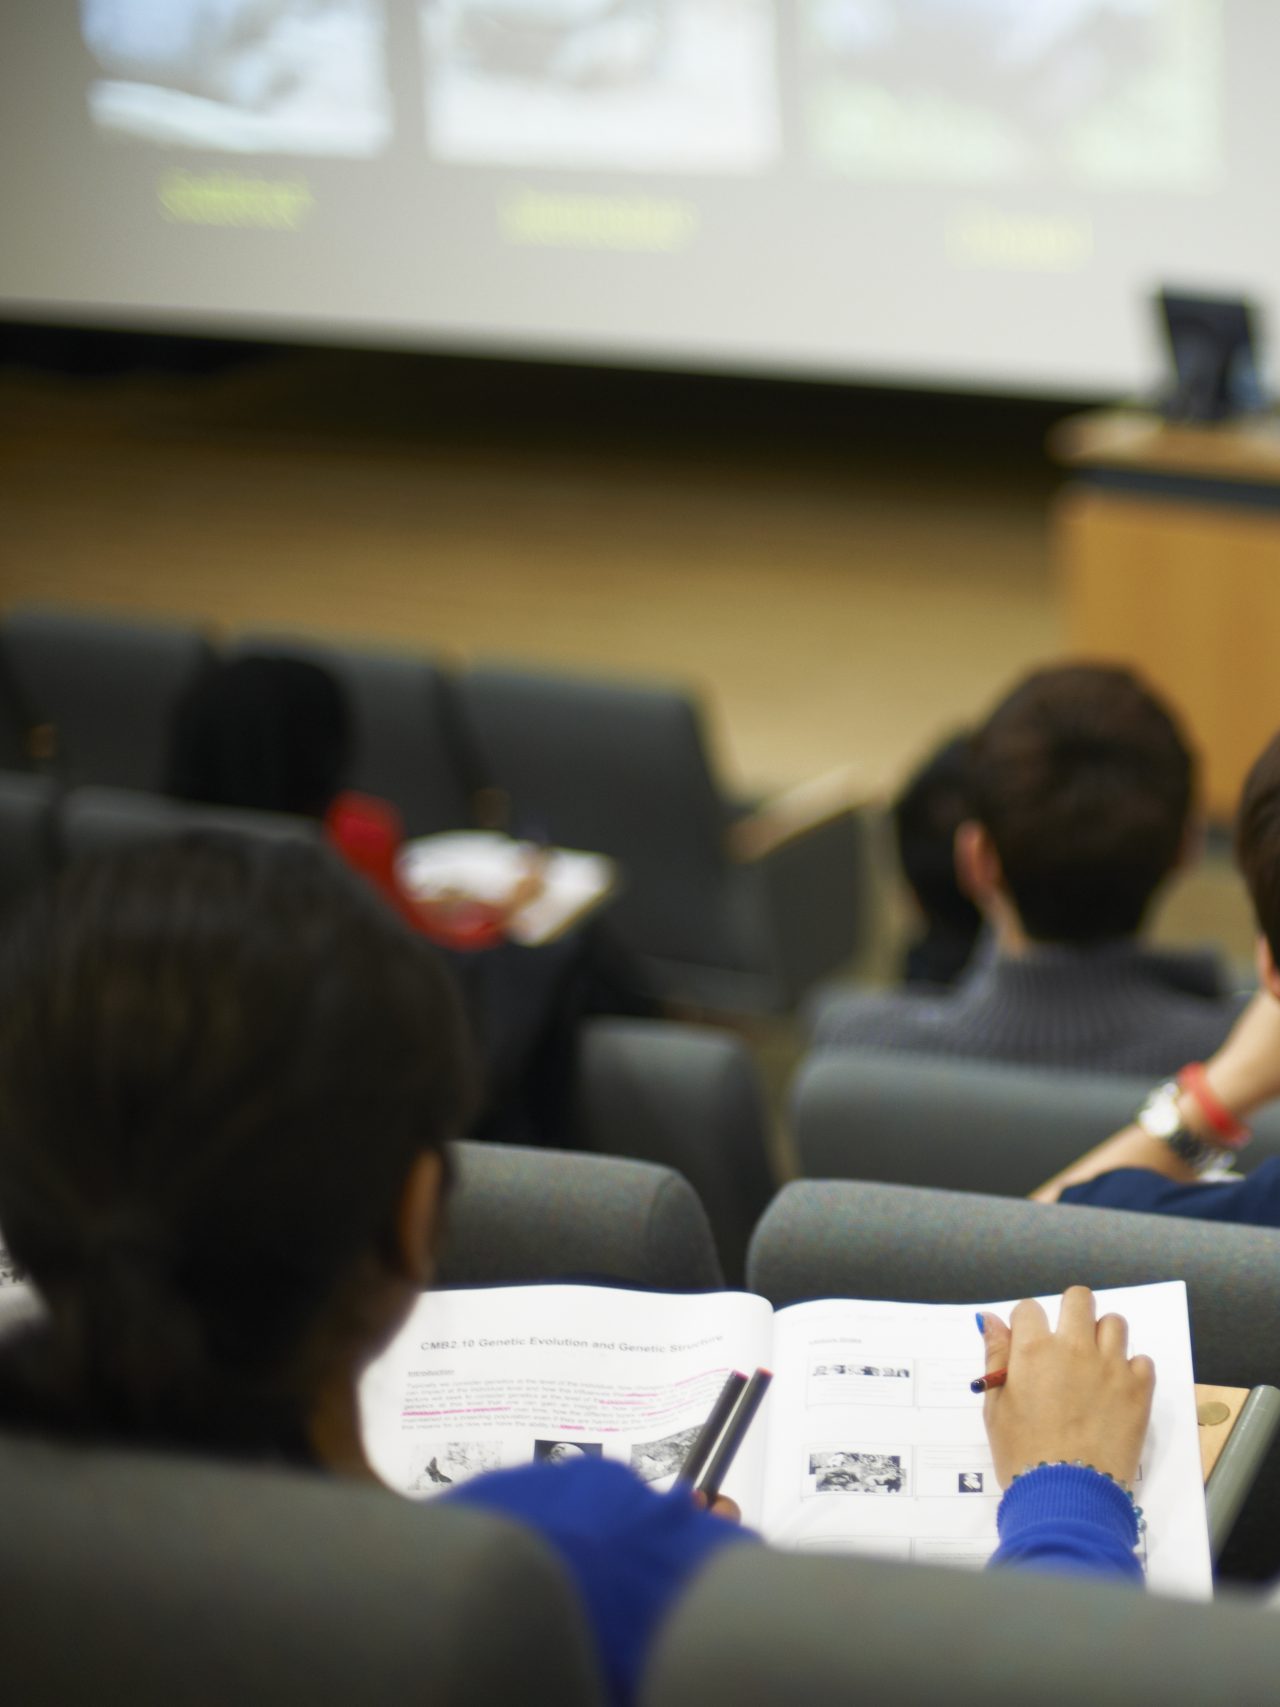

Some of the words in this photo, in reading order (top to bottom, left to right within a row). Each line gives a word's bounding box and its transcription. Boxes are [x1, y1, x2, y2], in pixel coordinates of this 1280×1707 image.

[478, 1337, 527, 1347] Genetic
[529, 1337, 589, 1347] Evolution
[591, 1340, 616, 1350] and
[618, 1342, 666, 1353] Genetic
[669, 1335, 724, 1353] Structure
